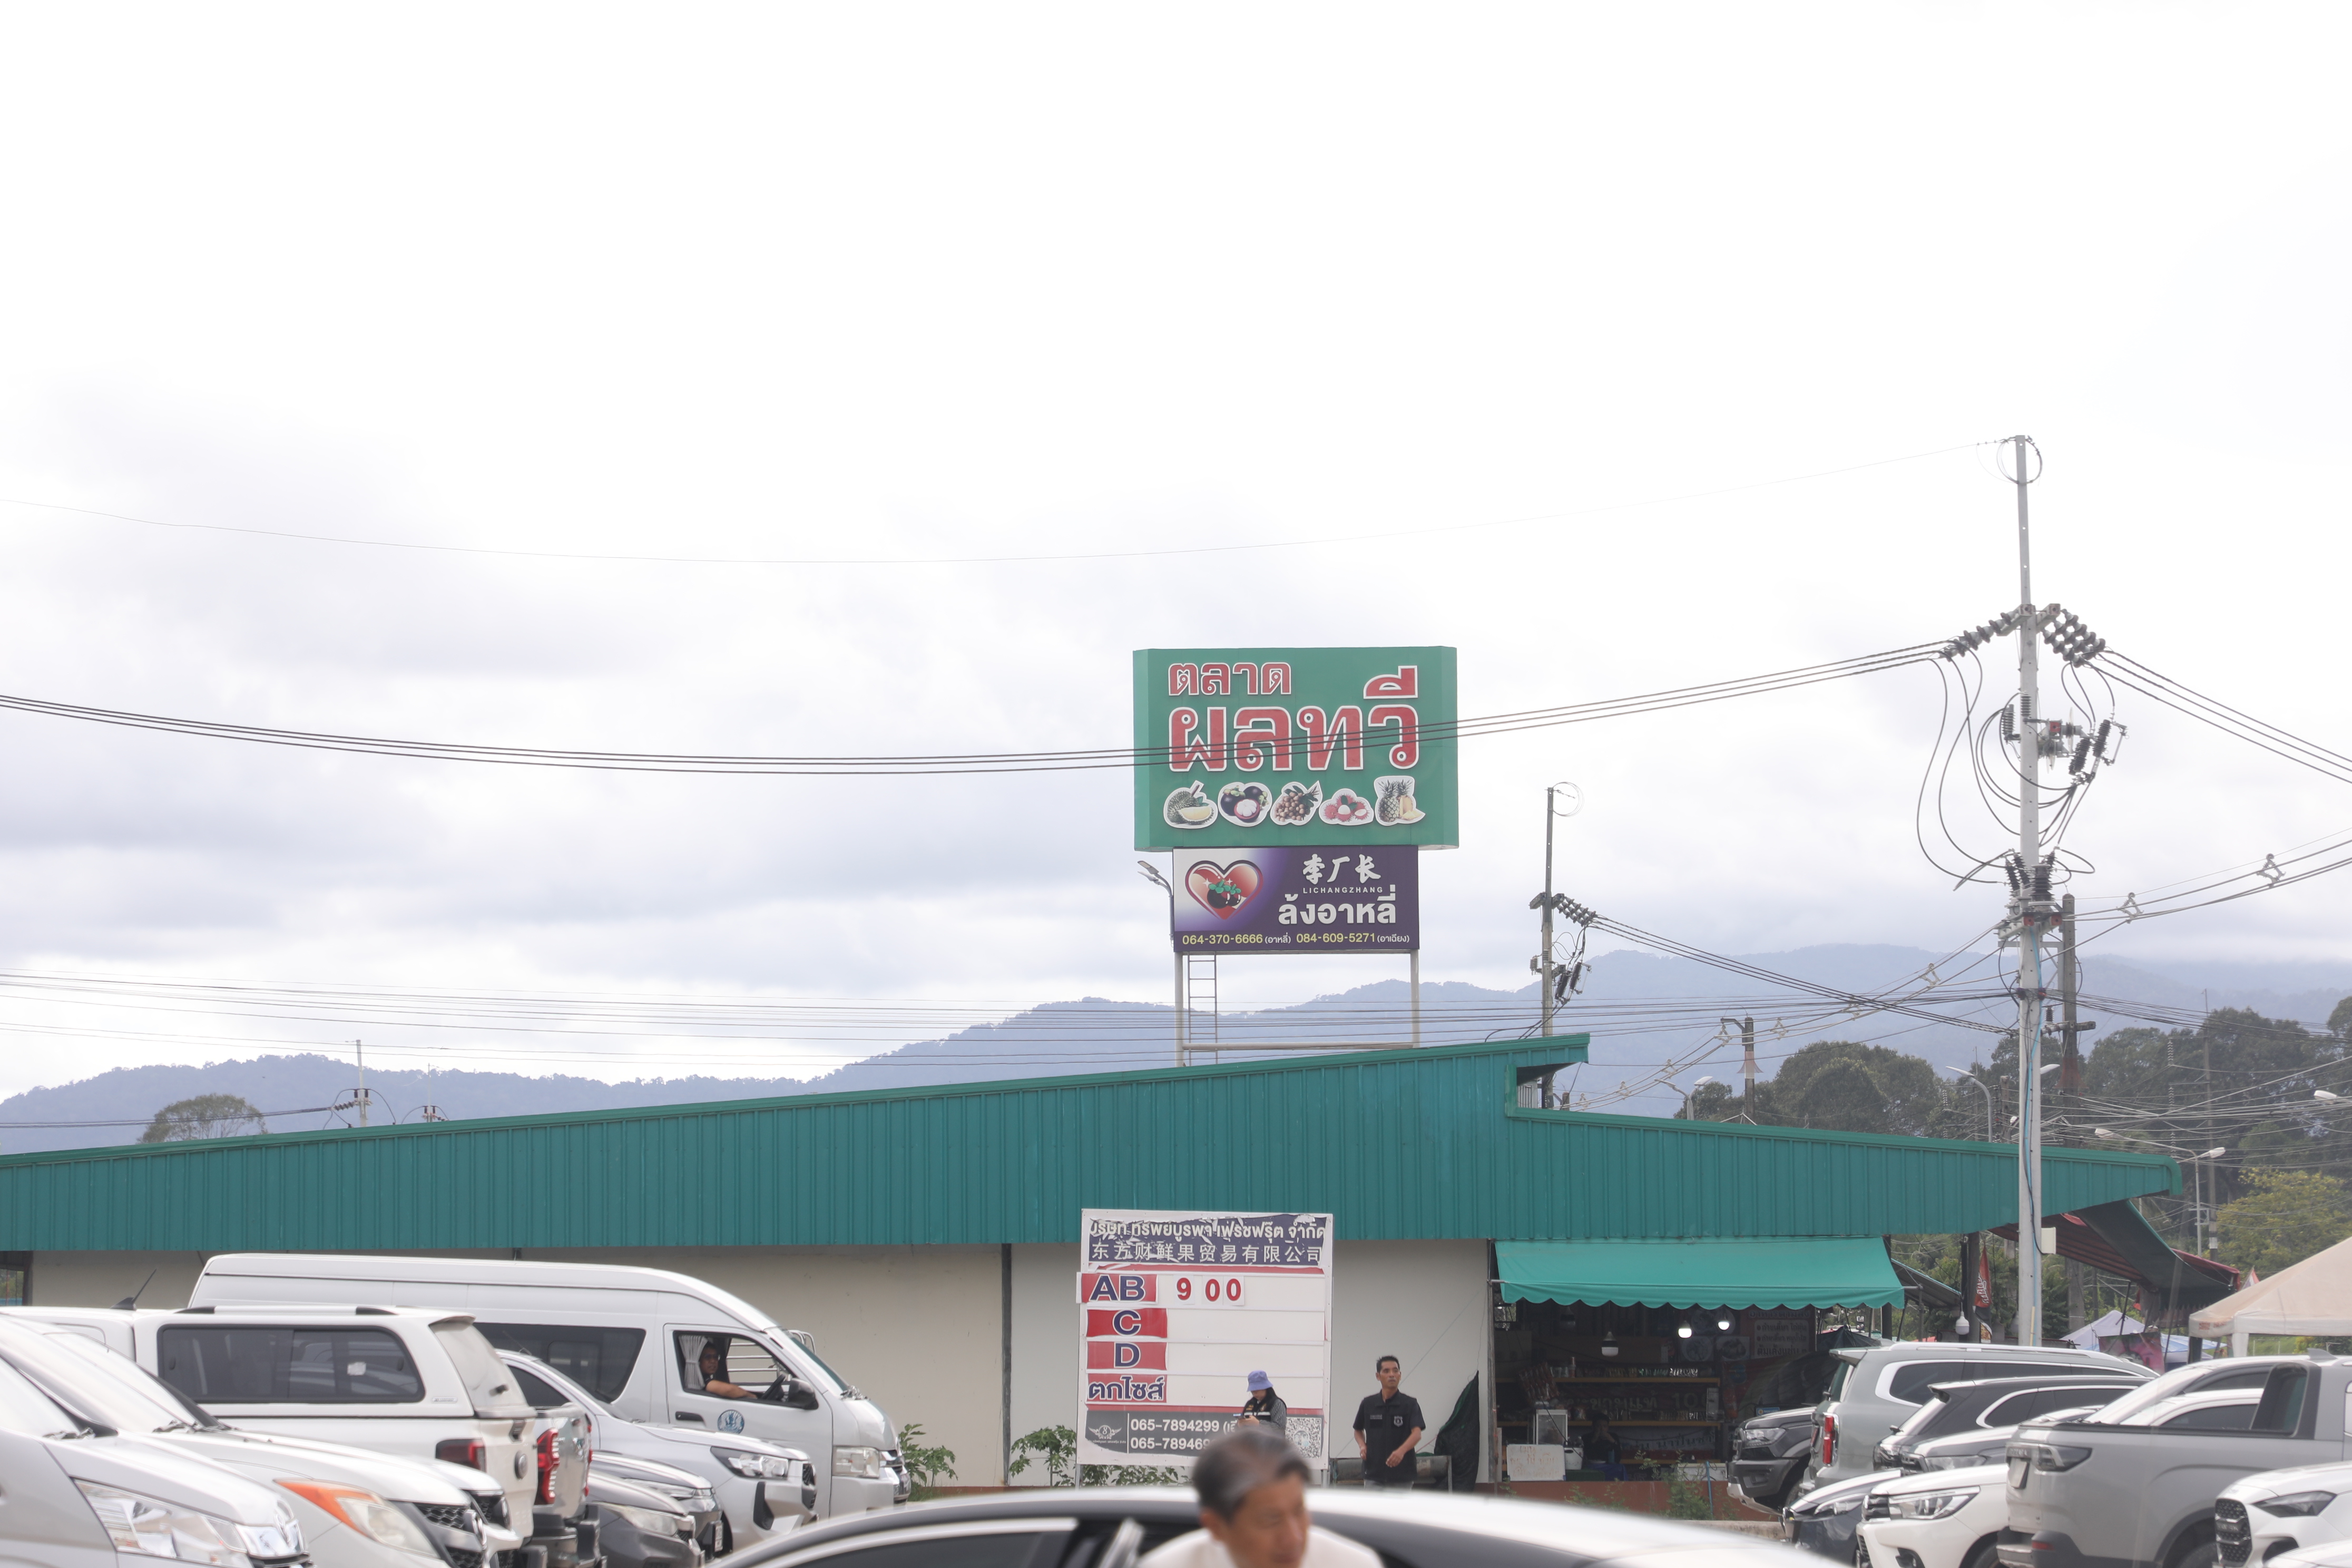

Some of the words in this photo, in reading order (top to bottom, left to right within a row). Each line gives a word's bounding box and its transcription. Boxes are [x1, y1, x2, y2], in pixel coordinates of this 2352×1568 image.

[1168, 662, 1291, 696] ตลาด
[1169, 665, 1419, 772] ผลทวี
[1302, 854, 1381, 885] 李厂长
[1278, 884, 1396, 925] ล้งอาหลี่
[1182, 934, 1263, 945] 064-370-6666
[1296, 933, 1376, 943] 084-609-5271
[1088, 1275, 1146, 1302] AB
[1112, 1309, 1142, 1336] C
[1113, 1341, 1141, 1368] D
[1088, 1375, 1165, 1401] ตกไซส์
[1130, 1418, 1220, 1433] 065-7894299
